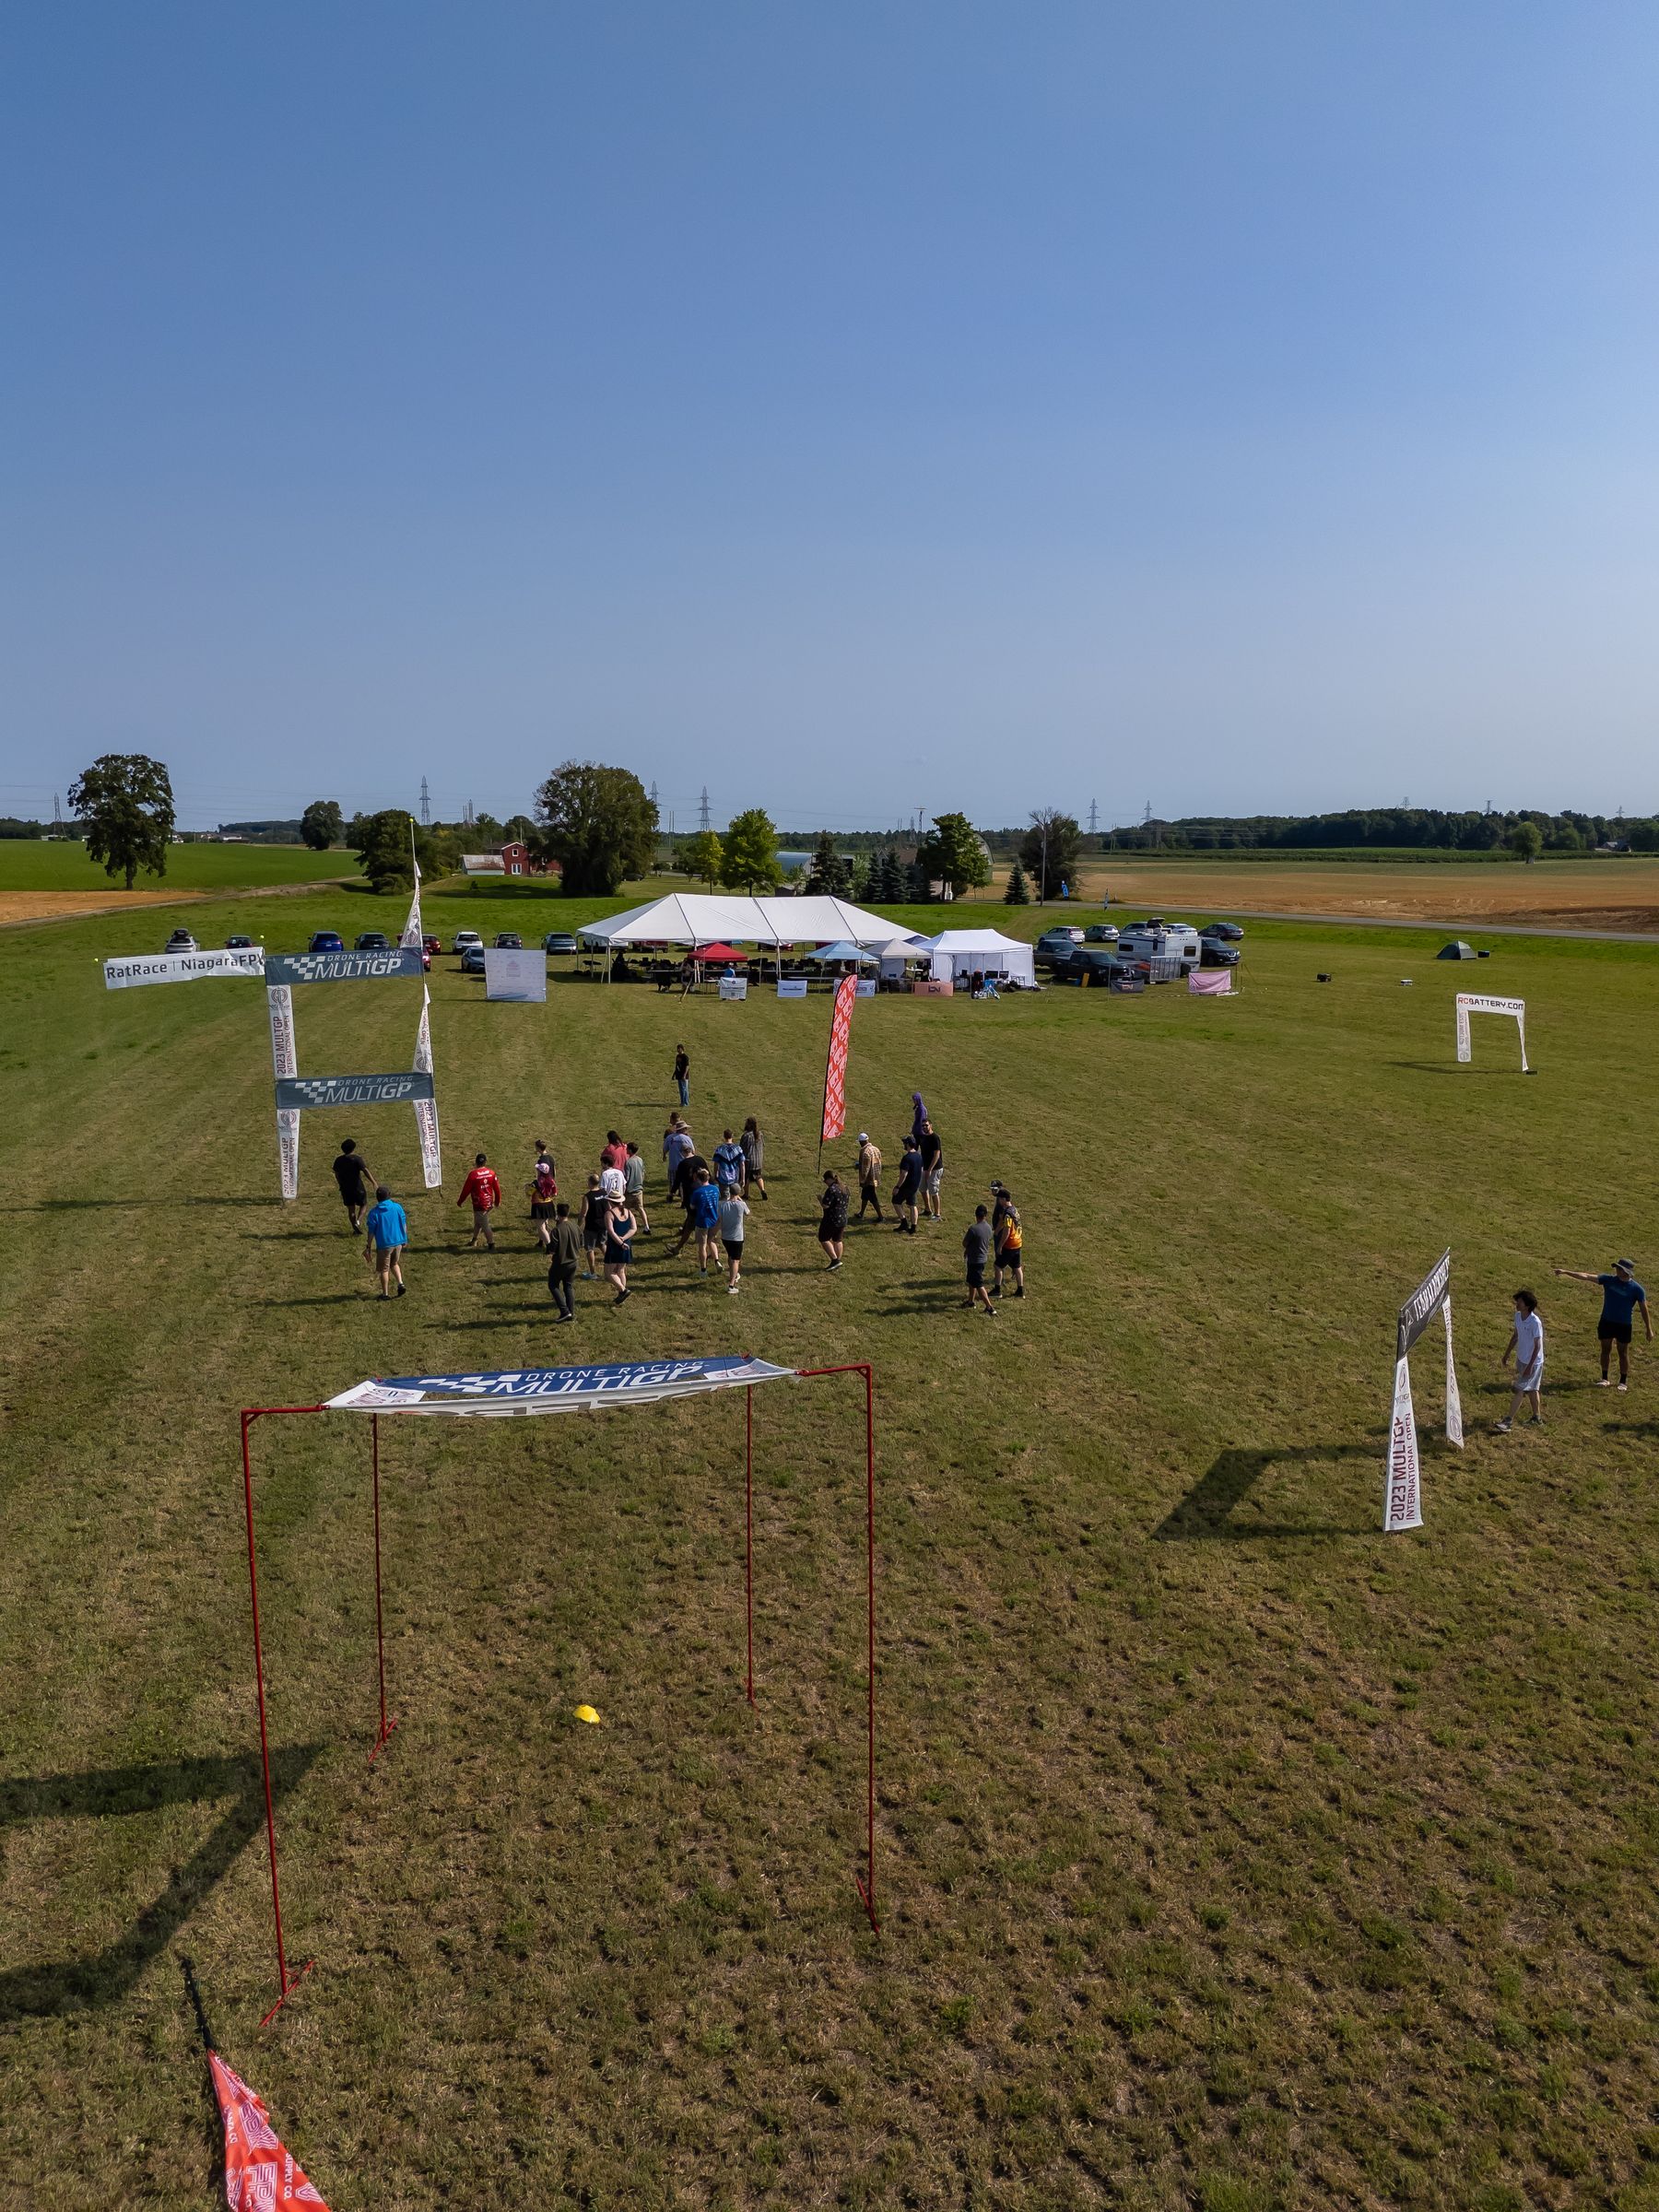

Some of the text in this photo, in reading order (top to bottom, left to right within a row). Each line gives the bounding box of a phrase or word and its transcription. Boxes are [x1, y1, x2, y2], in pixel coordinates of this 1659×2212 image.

[327, 950, 403, 962] DRONE RACING
[107, 962, 168, 979] RatRace
[314, 958, 402, 980] MULTIGP
[276, 1053, 287, 1075] 2023
[376, 1075, 413, 1085] RACING
[324, 1081, 413, 1103] MULTIGP
[490, 1365, 703, 1394] MULTIGP
[525, 1369, 607, 1382] DRONE
[618, 1360, 704, 1375] RACING
[1405, 1412, 1416, 1521] INTERNATIONAL OPEN
[1390, 1485, 1407, 1522] 2023
[284, 2152, 293, 2183] SUPPLY
